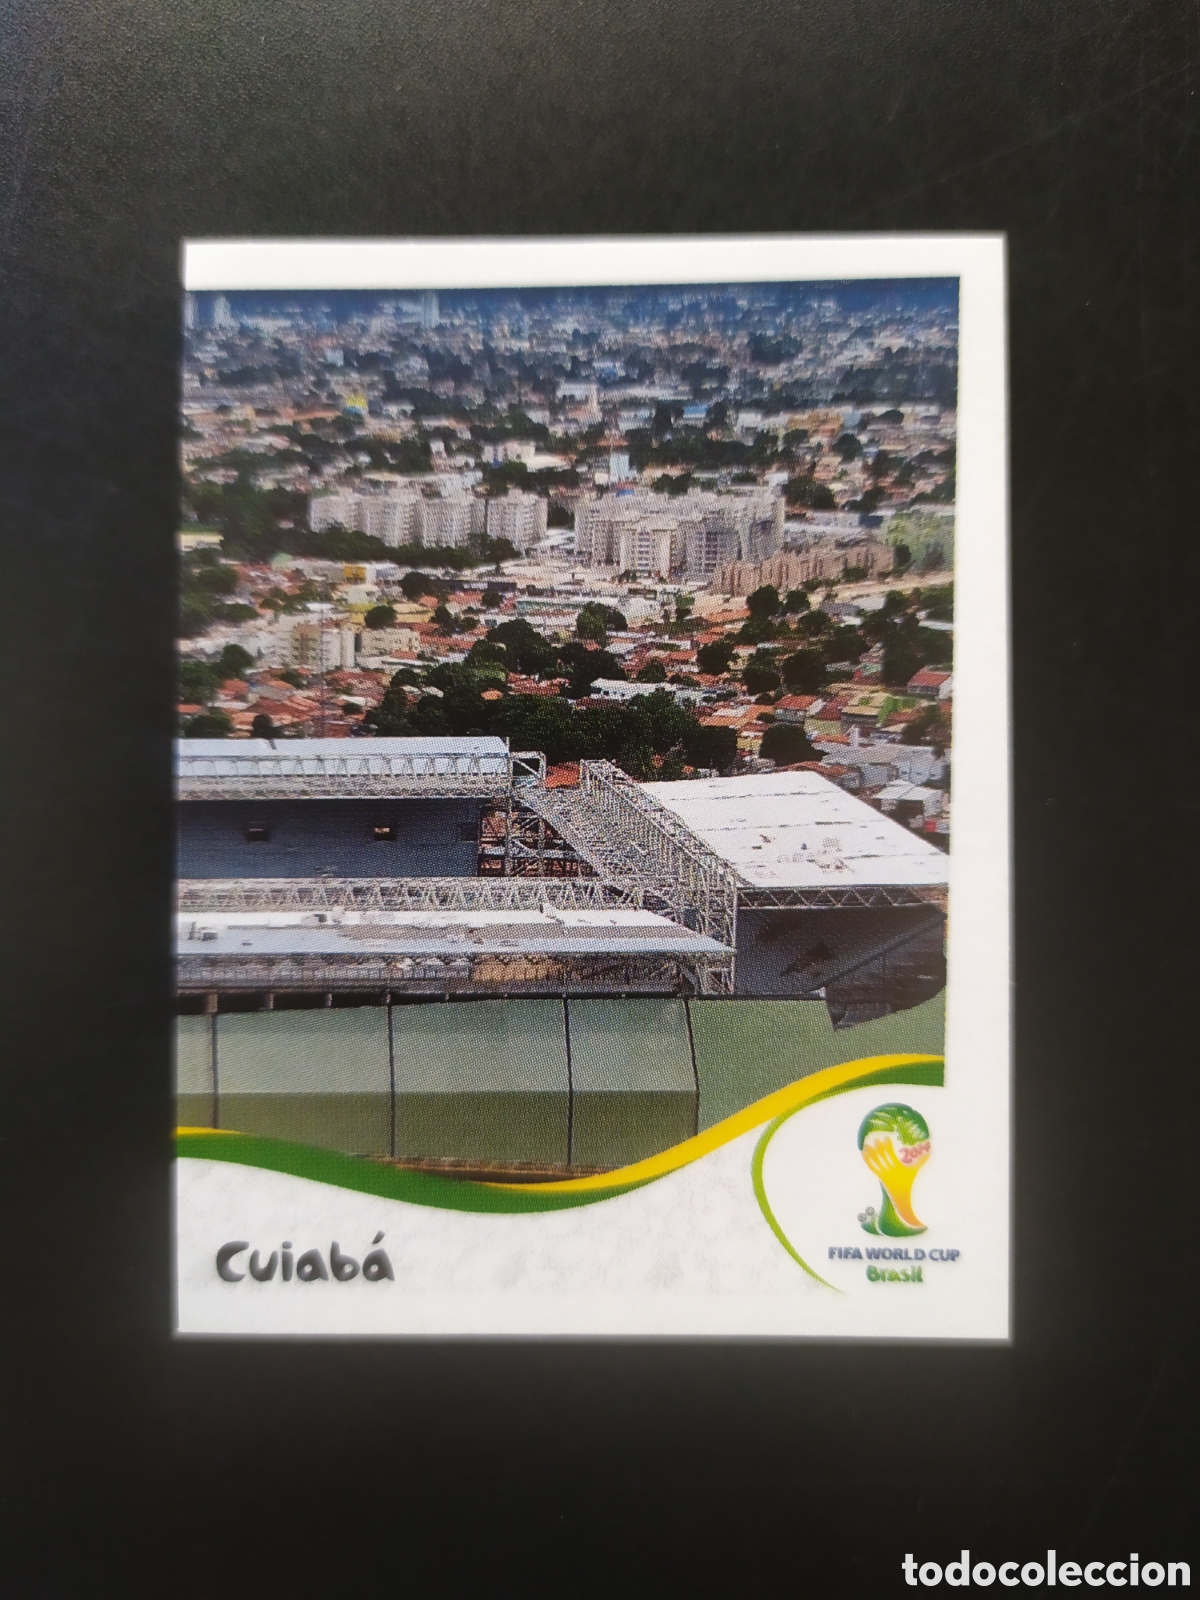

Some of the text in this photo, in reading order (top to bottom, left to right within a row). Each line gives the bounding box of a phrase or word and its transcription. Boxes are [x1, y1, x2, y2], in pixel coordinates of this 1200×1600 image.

[216, 1229, 396, 1283] Cuiabá
[827, 1246, 961, 1262] FIFA WORLD CUP
[866, 1264, 924, 1283] Brasil
